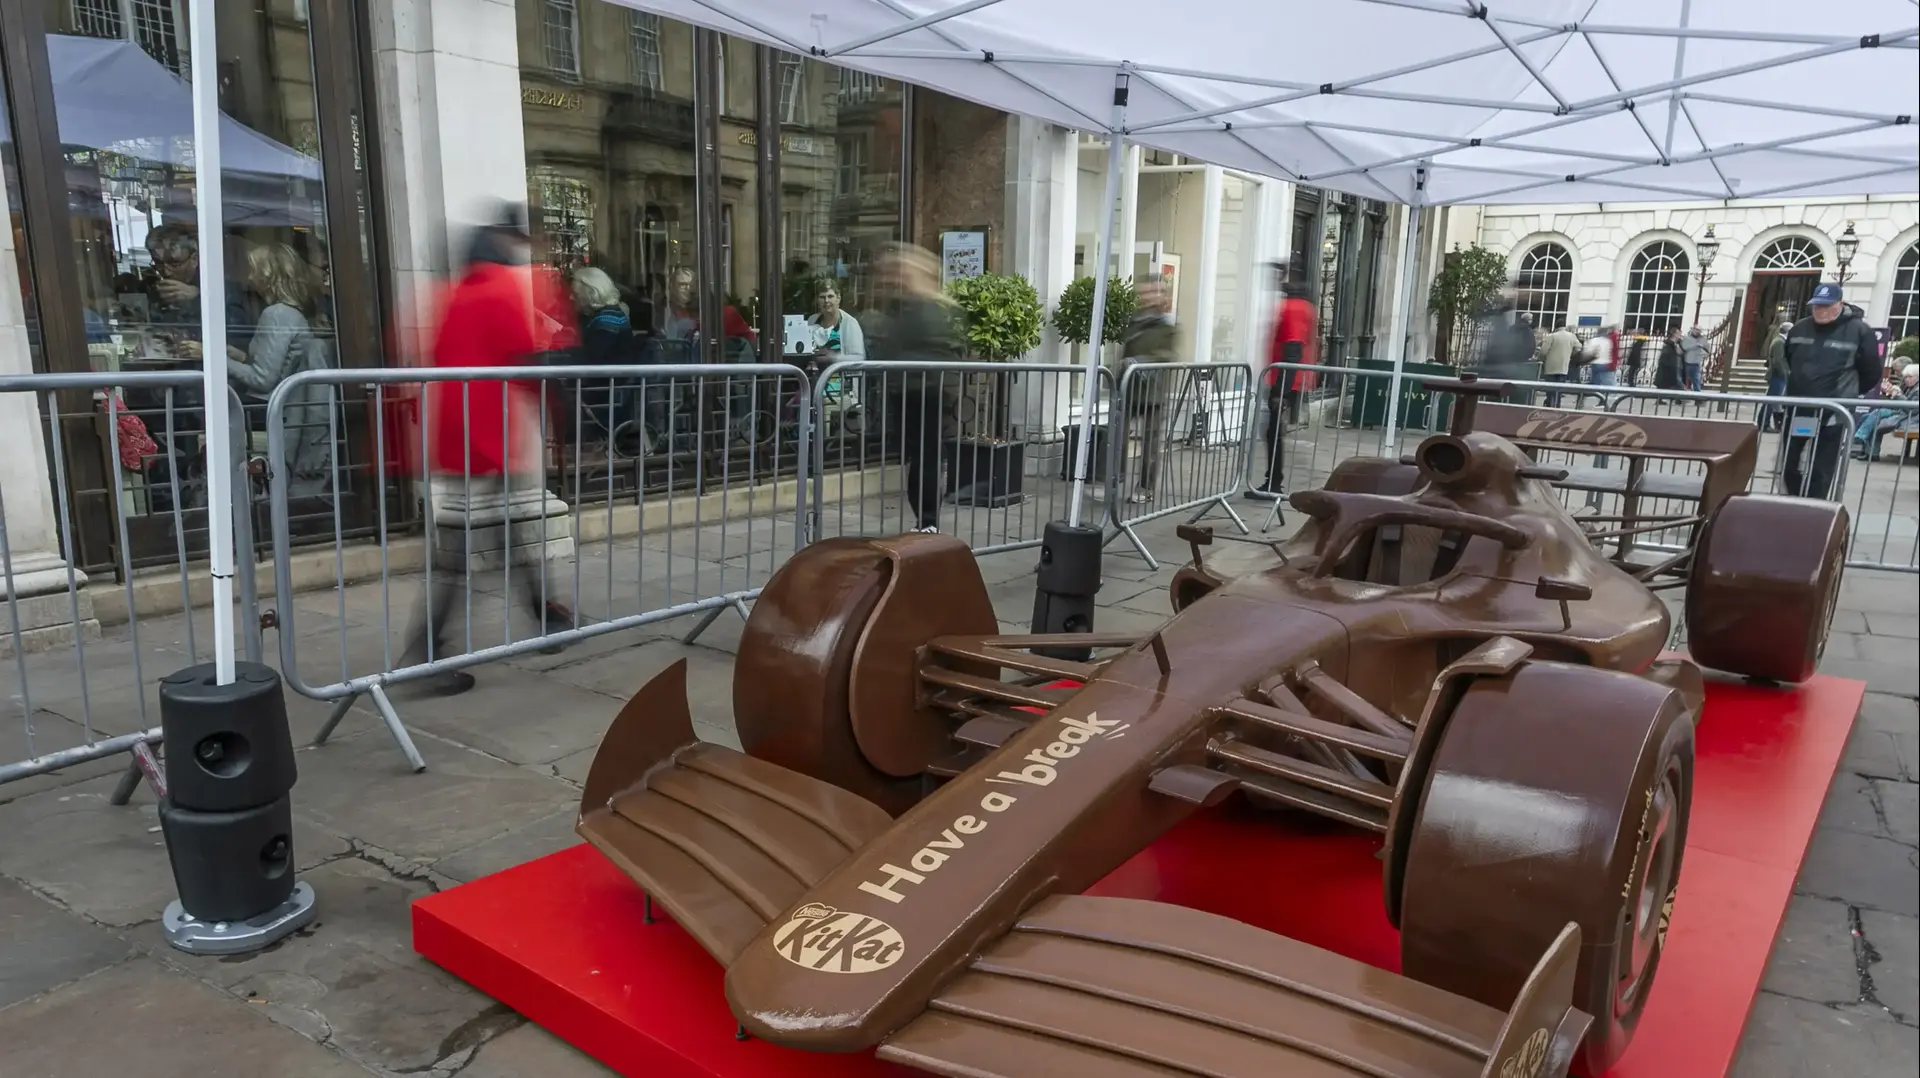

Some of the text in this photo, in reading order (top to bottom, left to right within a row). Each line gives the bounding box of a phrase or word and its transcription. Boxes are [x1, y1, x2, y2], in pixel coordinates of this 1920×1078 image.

[1404, 391, 1427, 400] IVY
[1527, 415, 1645, 447] KitKat
[857, 711, 1121, 904] Have a break
[1621, 855, 1637, 898] Have
[776, 913, 902, 971] KitKat
